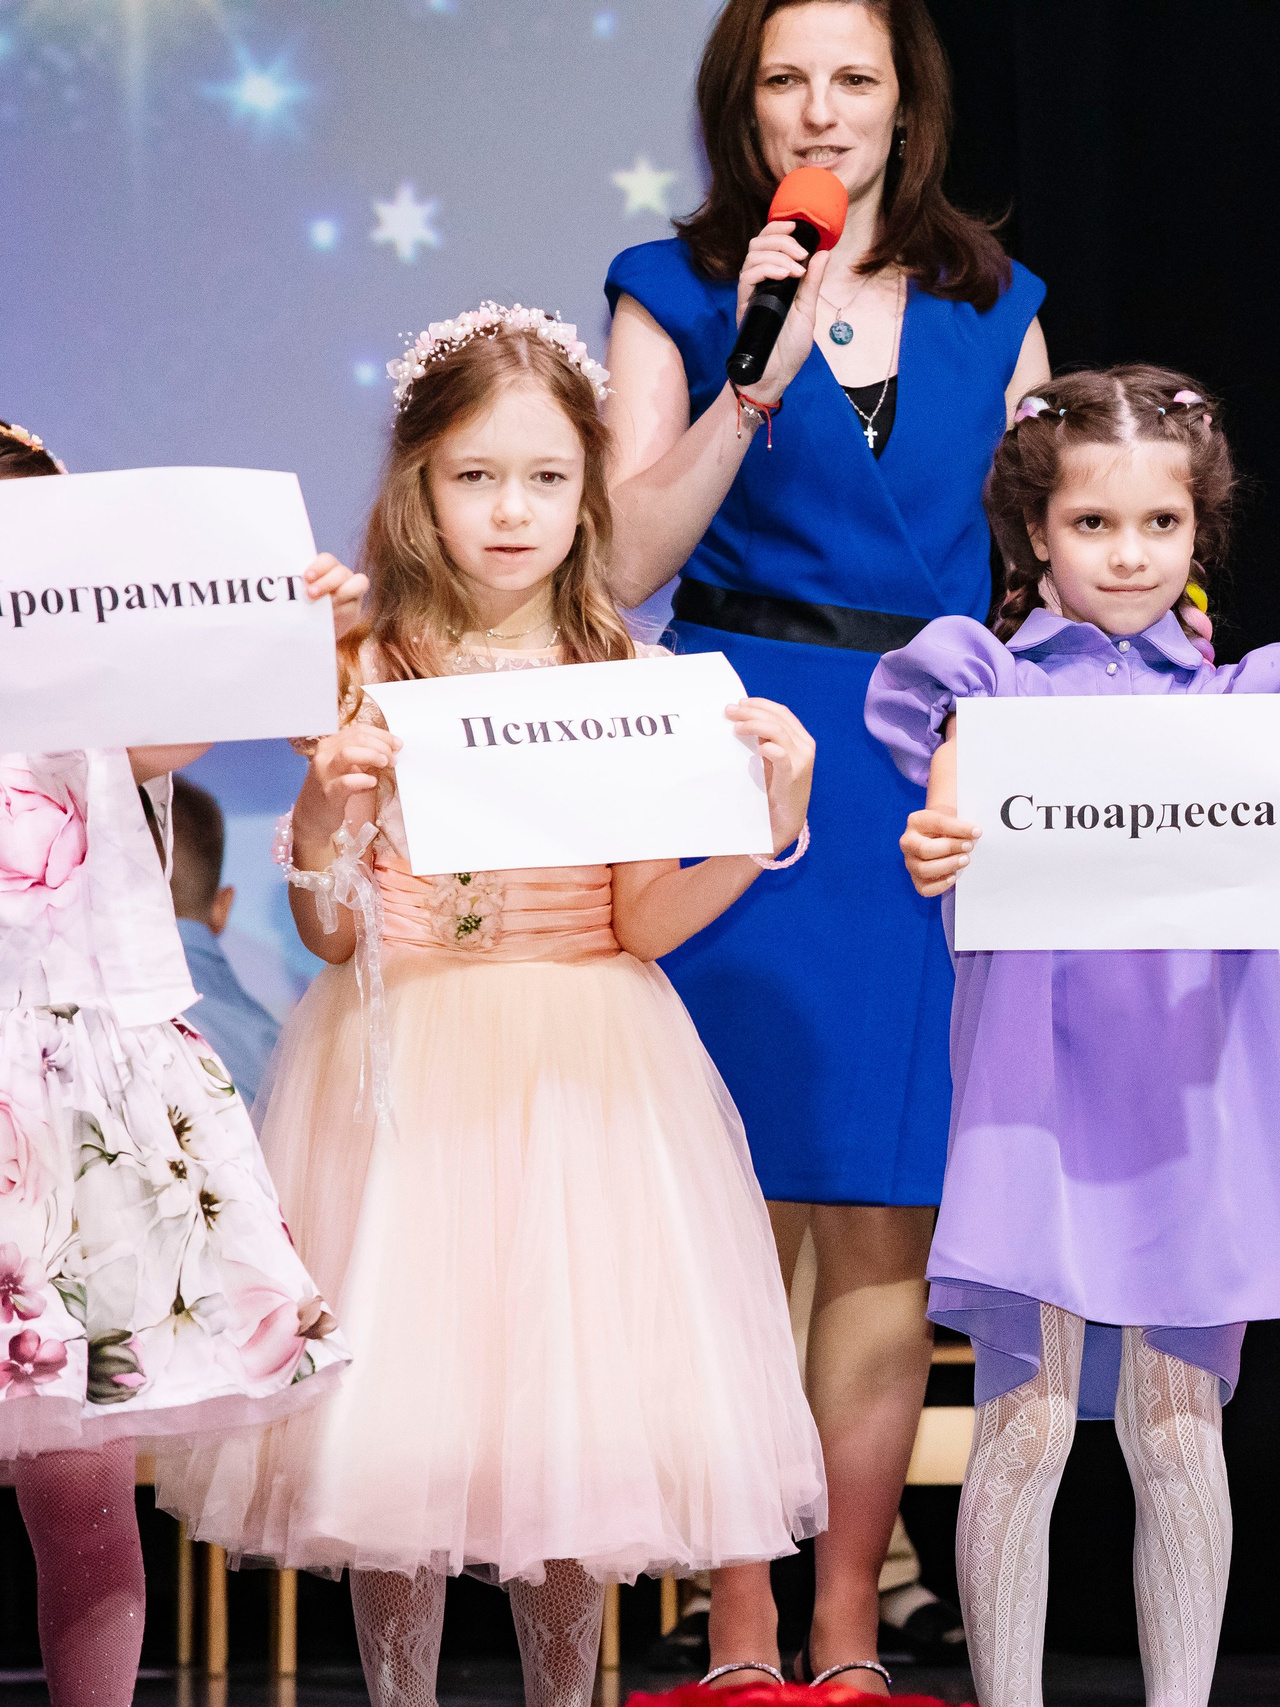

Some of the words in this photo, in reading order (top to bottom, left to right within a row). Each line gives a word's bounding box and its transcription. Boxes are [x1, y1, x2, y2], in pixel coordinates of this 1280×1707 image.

[0, 575, 304, 628] рограммист
[459, 713, 680, 748] Психолог
[1000, 794, 1277, 839] Стюардесса
